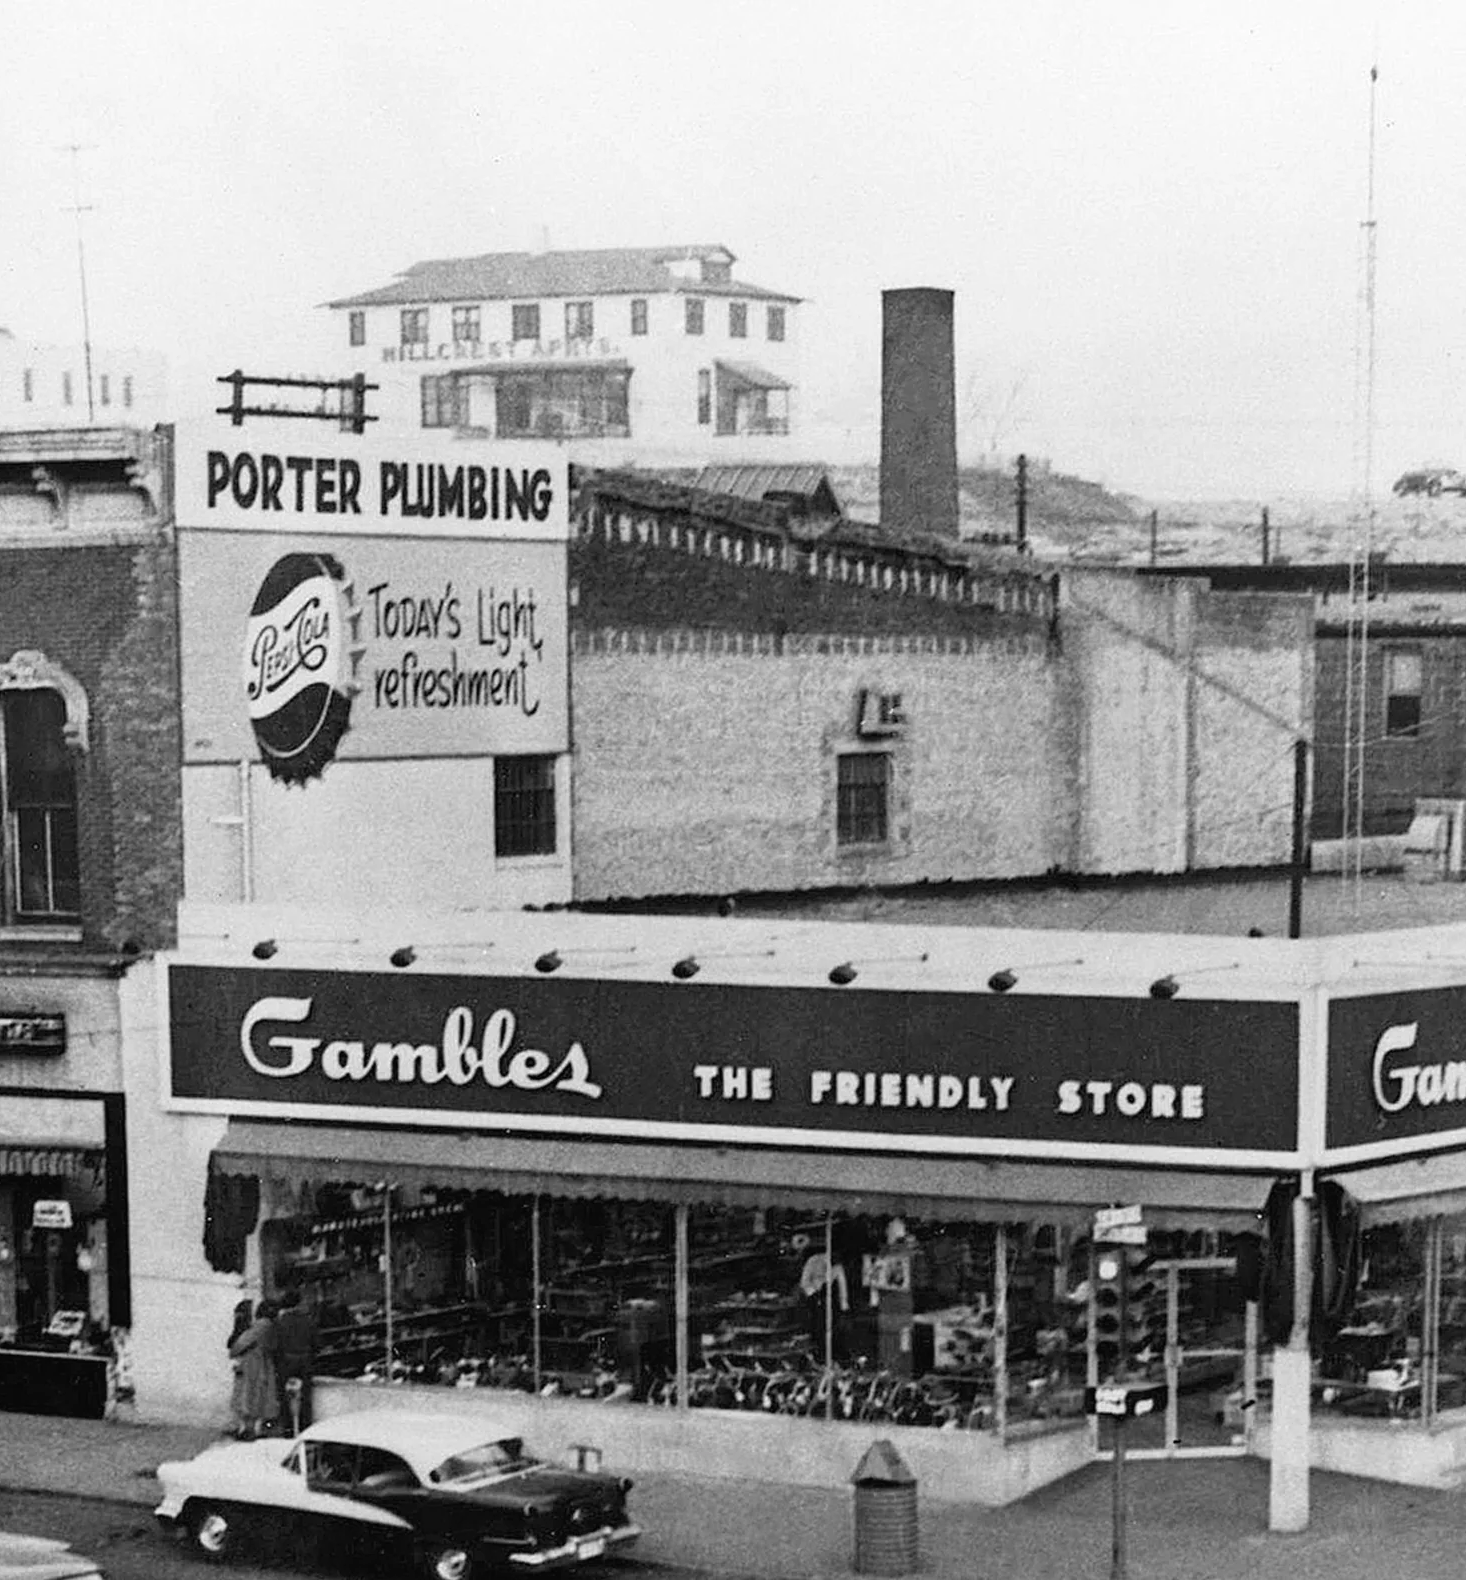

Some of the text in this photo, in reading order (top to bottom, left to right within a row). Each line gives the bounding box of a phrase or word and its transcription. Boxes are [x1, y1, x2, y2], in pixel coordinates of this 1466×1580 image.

[207, 450, 554, 522] PORTER PLUMBING
[374, 647, 541, 717] refreshment
[240, 996, 1206, 1120] Gambles THE FRIENDLY STORE
